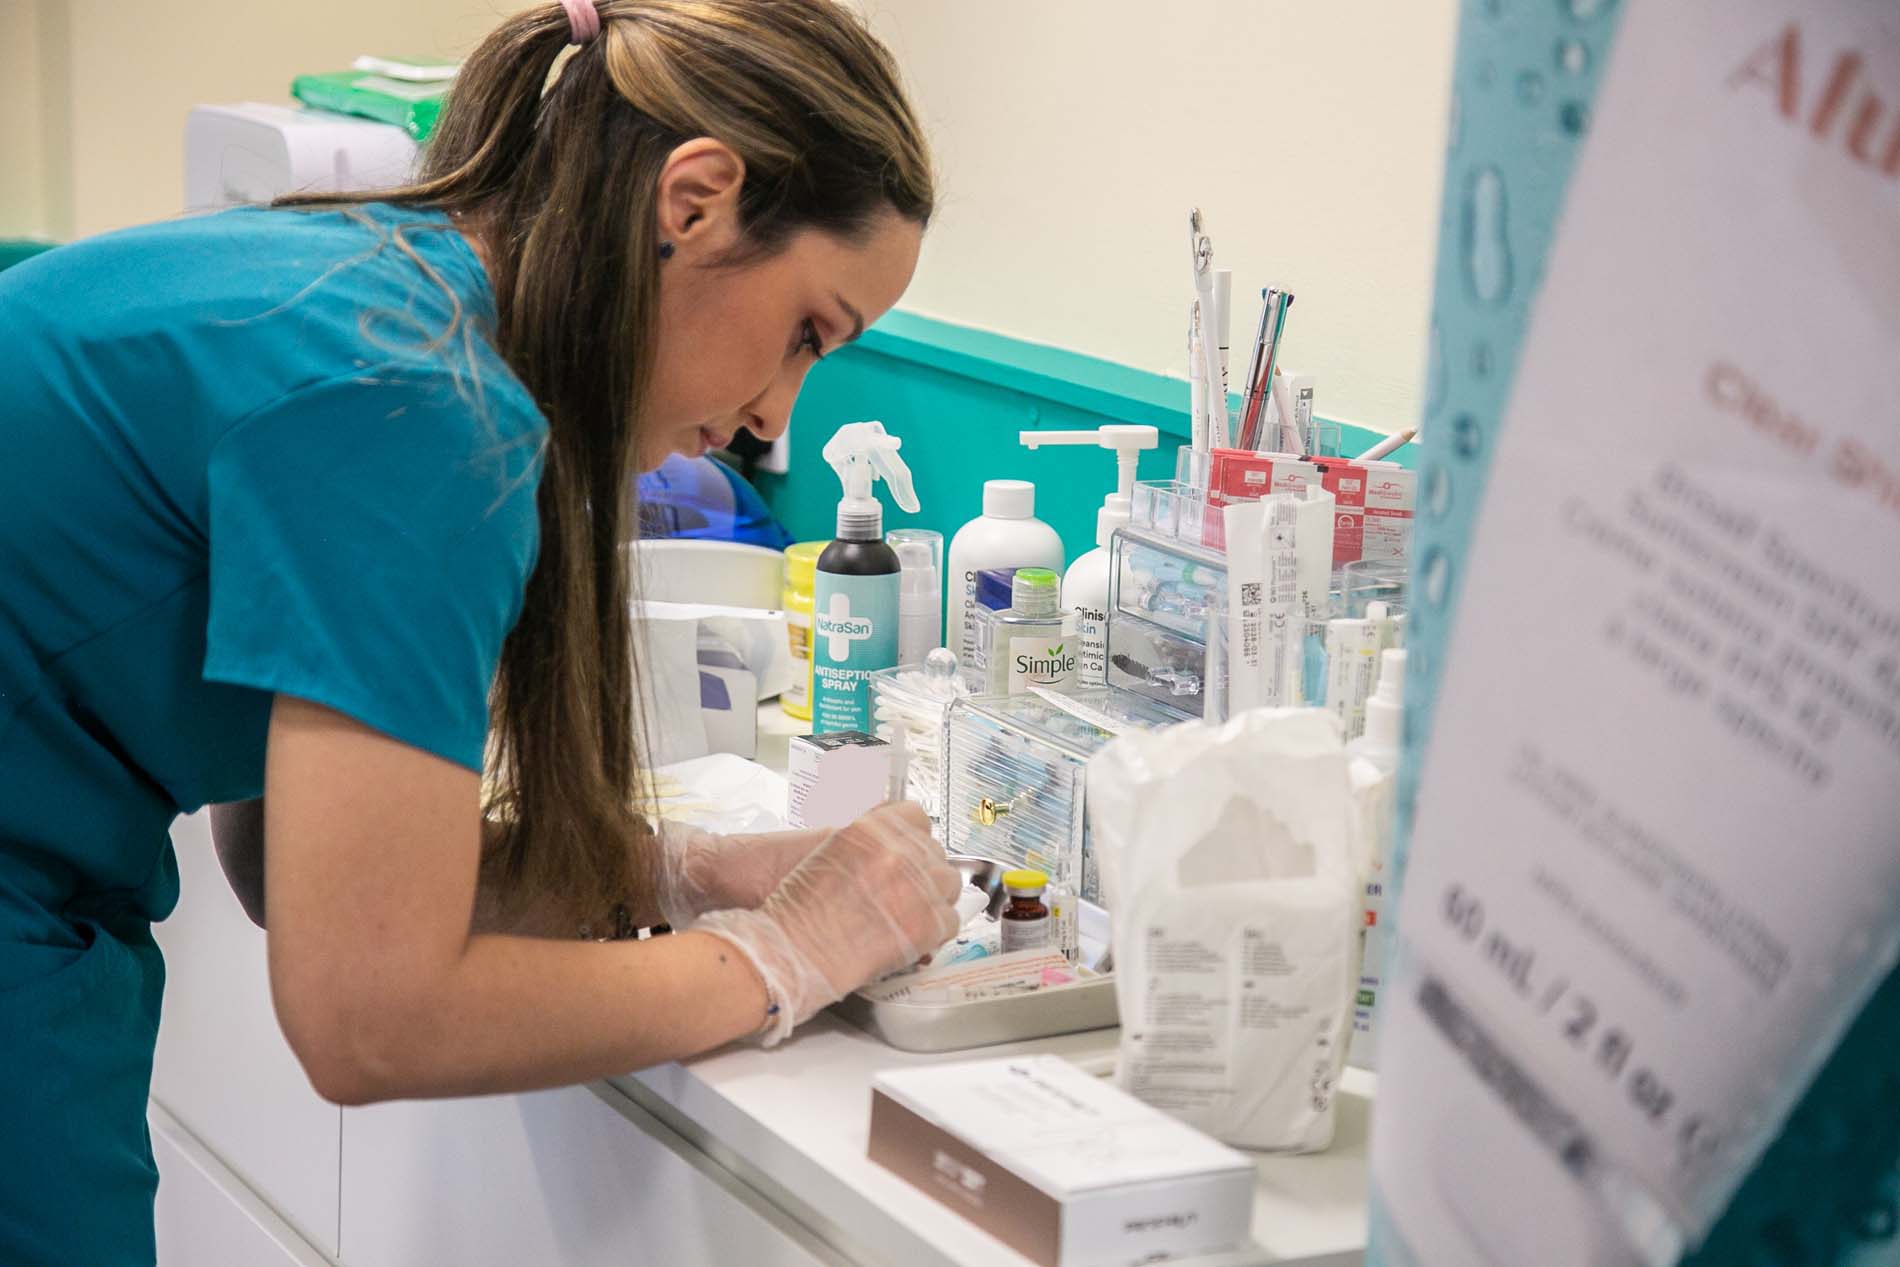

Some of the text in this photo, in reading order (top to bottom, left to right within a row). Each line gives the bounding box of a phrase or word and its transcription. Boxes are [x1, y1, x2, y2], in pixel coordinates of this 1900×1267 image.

[816, 618, 870, 635] NatraSan
[1016, 654, 1076, 678] Simple
[821, 680, 858, 692] SPRAY
